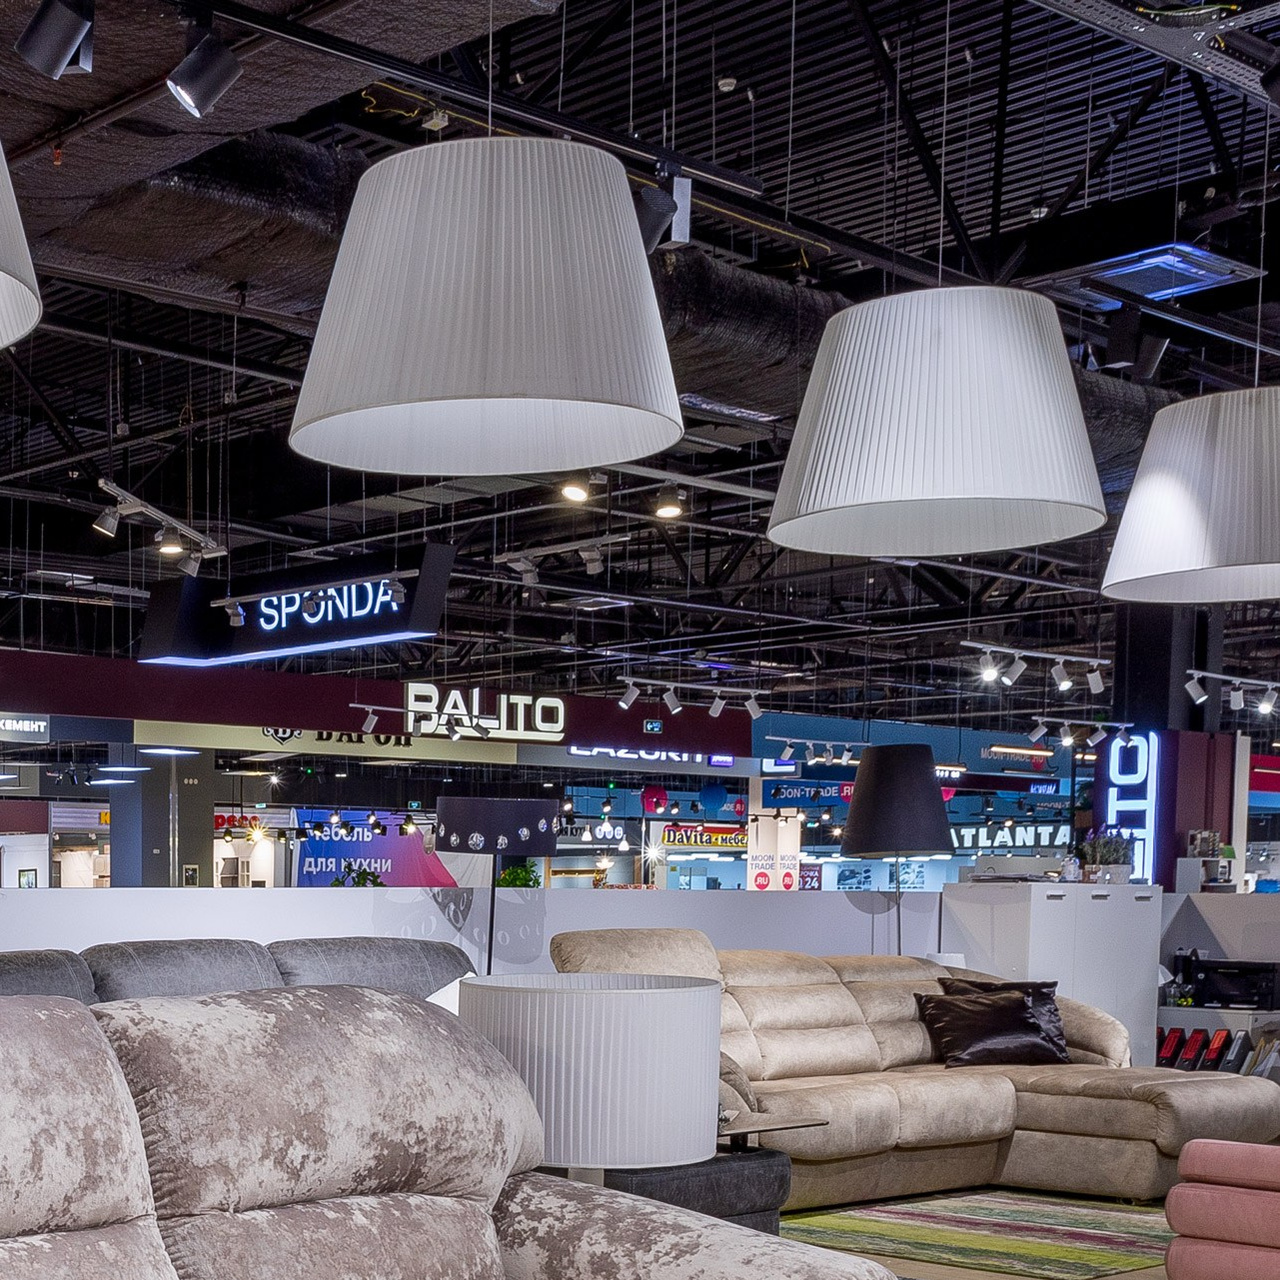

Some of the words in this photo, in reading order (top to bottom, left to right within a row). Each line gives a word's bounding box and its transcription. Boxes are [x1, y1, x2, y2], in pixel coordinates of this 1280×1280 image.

[259, 579, 399, 630] SPONDA
[405, 682, 565, 742] BALITO
[667, 829, 712, 844] DaVita
[303, 857, 337, 875] для
[751, 854, 775, 862] MOON
